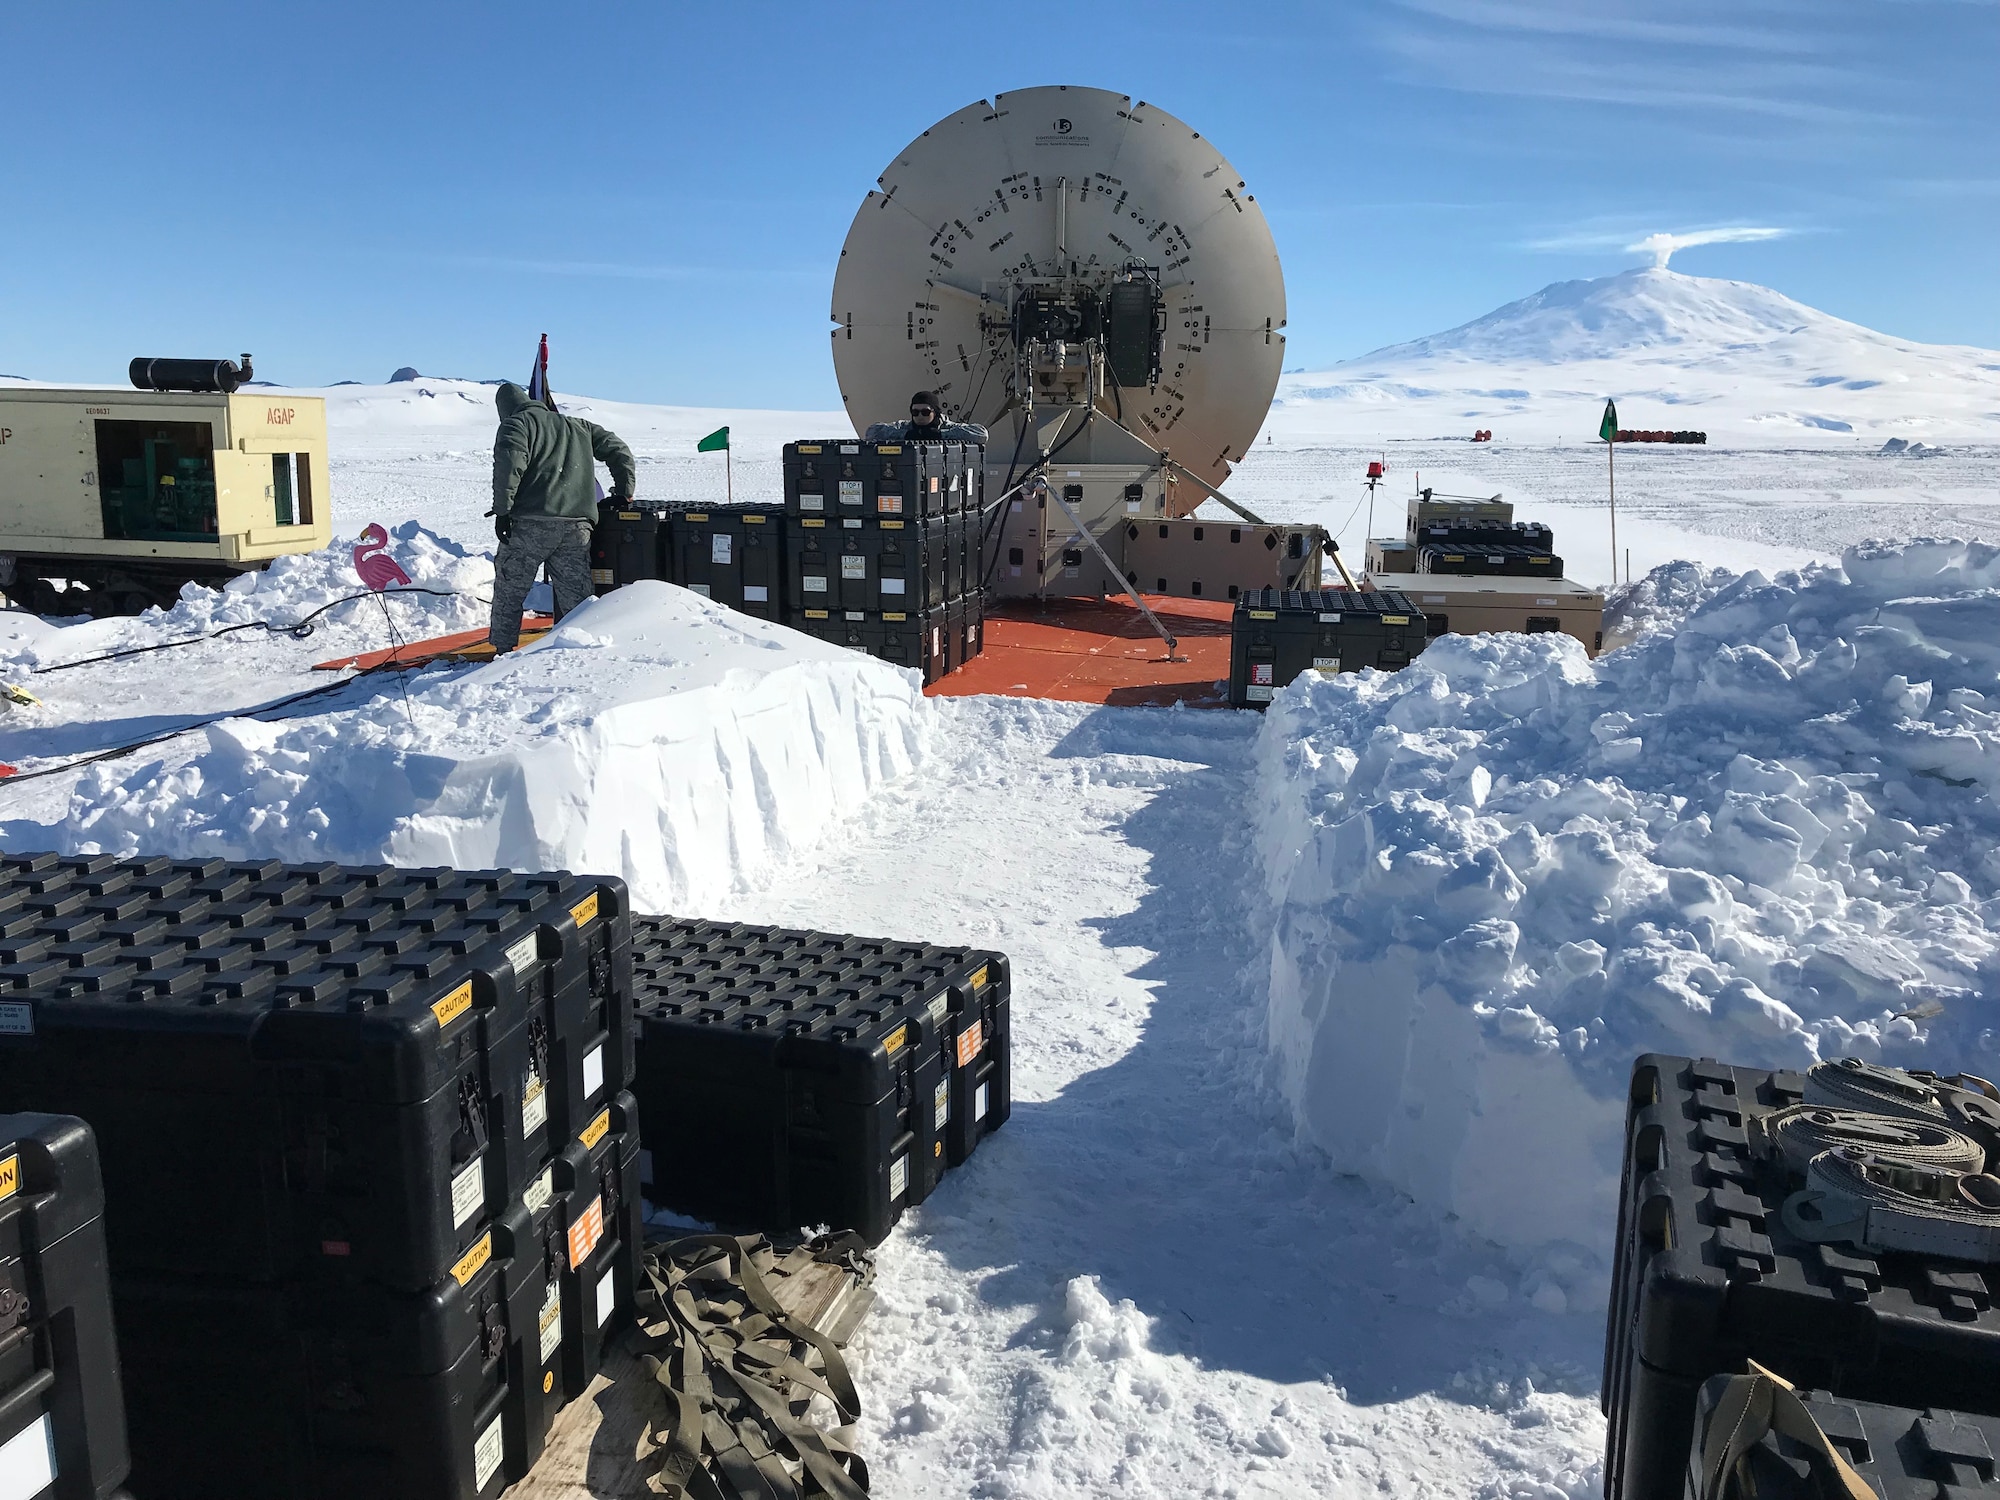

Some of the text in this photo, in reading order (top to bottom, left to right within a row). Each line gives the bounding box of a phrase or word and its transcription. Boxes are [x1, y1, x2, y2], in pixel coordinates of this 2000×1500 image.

[267, 407, 295, 425] AGAP
[0, 427, 13, 445] P
[575, 900, 597, 922] CAUTION
[439, 989, 470, 1018] CAUTION
[522, 1083, 542, 1104] AUTIO
[586, 1117, 607, 1143] CAUTION
[460, 1241, 488, 1276] CAUTION
[540, 1303, 559, 1331] AUTION
